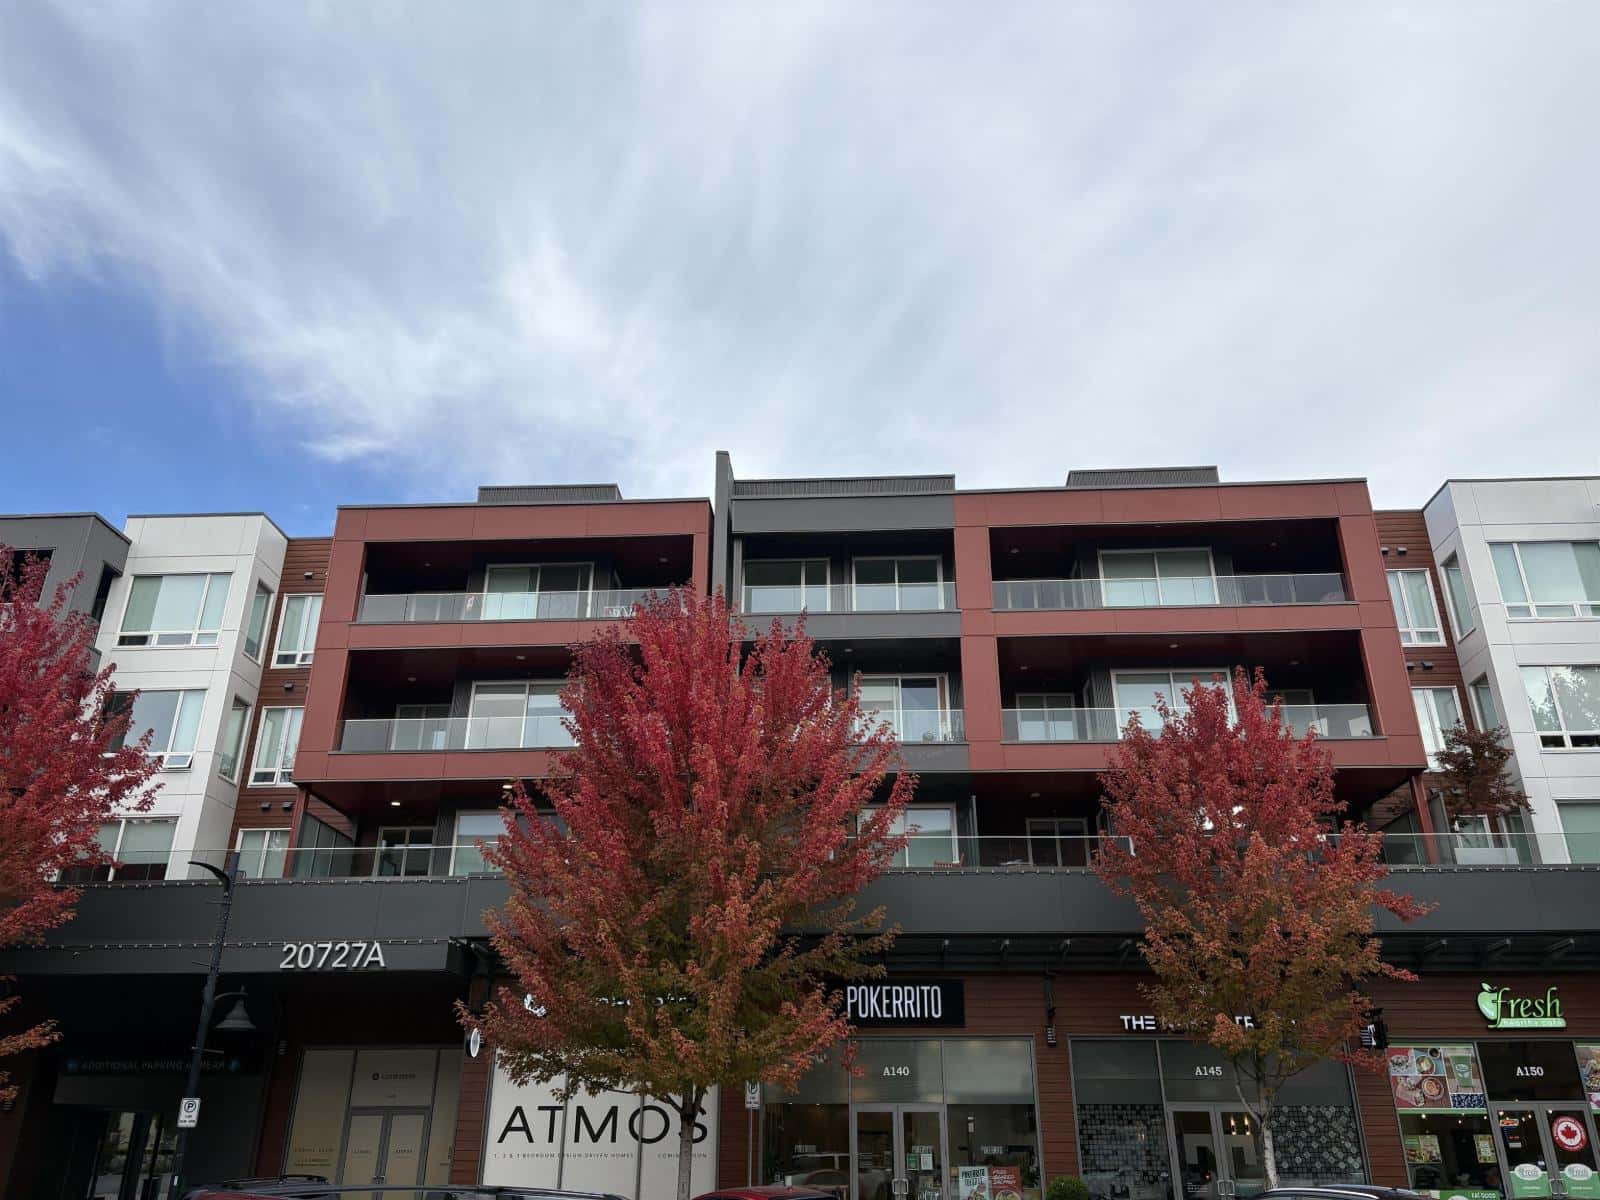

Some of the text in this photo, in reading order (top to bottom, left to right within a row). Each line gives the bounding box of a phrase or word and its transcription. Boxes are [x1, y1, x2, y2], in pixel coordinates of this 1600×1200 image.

[279, 942, 386, 969] 20727A
[846, 985, 942, 1019] POKERRITO
[1490, 986, 1563, 1028] fresh
[1119, 1015, 1156, 1030] THE
[883, 1066, 910, 1076] A140
[1195, 1066, 1223, 1076] A145
[1516, 1066, 1544, 1076] A150
[497, 1105, 708, 1144] ATMOS
[657, 1152, 684, 1160] COMIN
